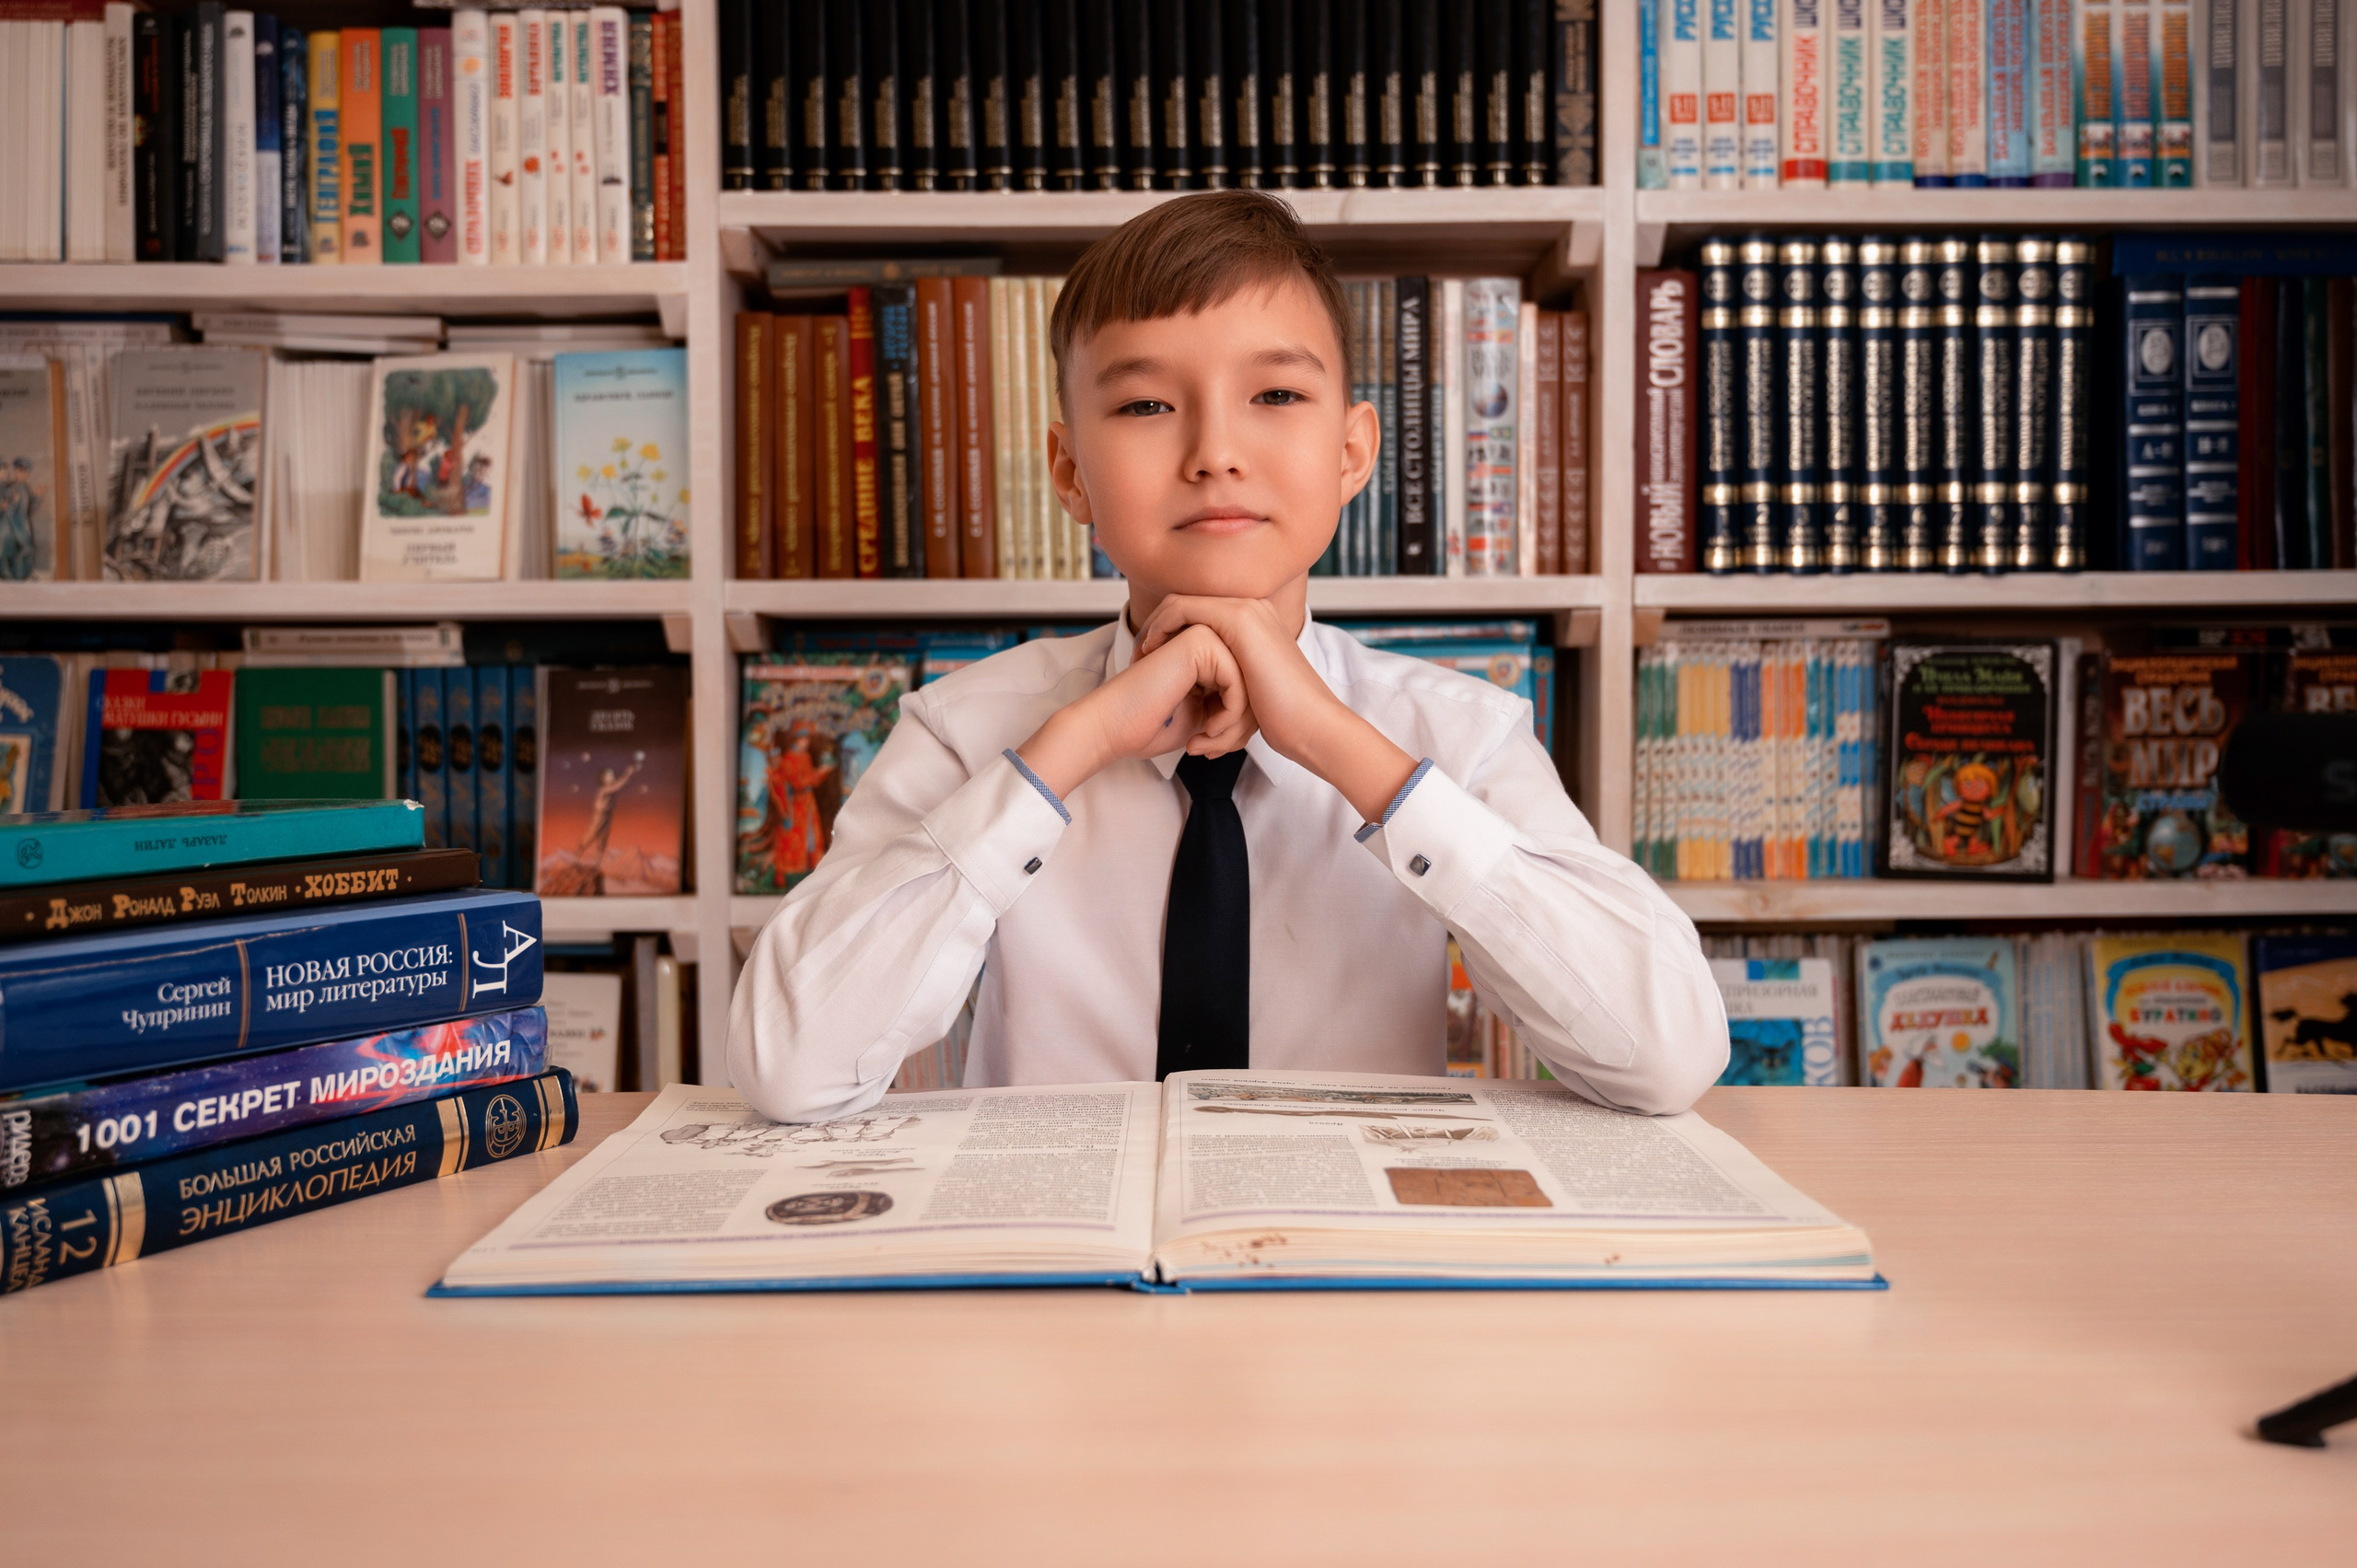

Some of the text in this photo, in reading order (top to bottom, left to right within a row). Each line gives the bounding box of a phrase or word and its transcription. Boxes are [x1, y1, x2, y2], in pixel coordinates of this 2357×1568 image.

[497, 25, 513, 99] ЗООЛОГИЯ
[602, 20, 621, 96] ХИМИЯ
[1794, 34, 1818, 154] СПРАВОЧНИК
[1837, 35, 1862, 155] СПРАВОЧНИК
[1881, 35, 1907, 155] СПРАВОЧНИК
[314, 110, 340, 223] ГЕОГРАФИЯ
[348, 144, 373, 216] ХИМИЯ
[1647, 280, 1685, 389] СЛОВАРЬ
[1401, 296, 1425, 524] ВСЕ СТОЛИЦЫ МИРА
[853, 376, 878, 574] СРЕДНИЕ ВЕКА
[1642, 483, 1685, 560] НОВЫЙ
[1718, 505, 1728, 526] 1
[1757, 504, 1771, 525] 2
[1797, 506, 1810, 525] 3
[1834, 505, 1849, 523] 4
[1875, 505, 1887, 525] 5
[1912, 505, 1925, 525] 6
[1951, 504, 1962, 525] 7
[1990, 505, 2004, 523] 9
[2121, 685, 2225, 736] ВЕСЬ
[2127, 738, 2220, 789] МИР
[134, 834, 227, 852] ЛАЗАРЬ ЛАГИН
[305, 868, 399, 898] ХОББИТ
[157, 976, 231, 1005] Сергей
[265, 944, 454, 990] НОВАЯ РОССИЯ:
[266, 970, 448, 1014] мир литературы
[122, 1000, 231, 1035] Чупринин
[76, 1039, 512, 1154] 1001 СЕКРЕТ МИРОЗДАНИЯ
[179, 1123, 417, 1201] БОЛЬШАЯ РОССИЙСКАЯ
[178, 1150, 417, 1237] ЭНЦИКЛОПЕДИЯ
[60, 1208, 98, 1267] 12
